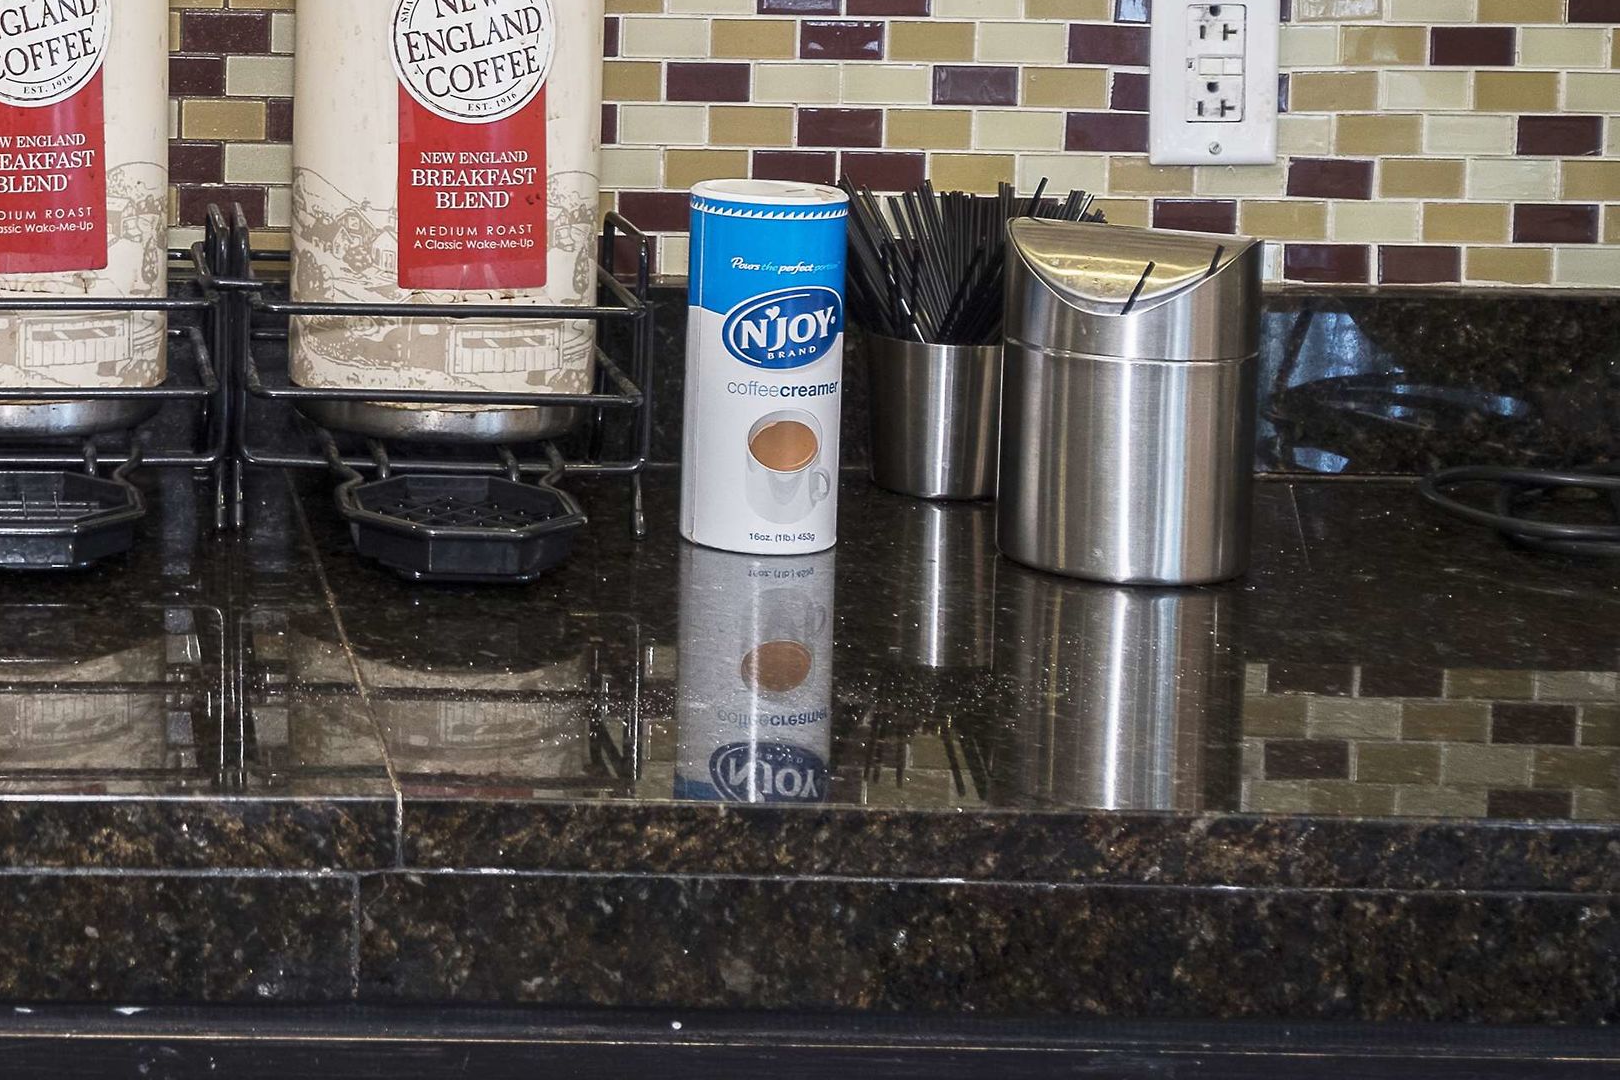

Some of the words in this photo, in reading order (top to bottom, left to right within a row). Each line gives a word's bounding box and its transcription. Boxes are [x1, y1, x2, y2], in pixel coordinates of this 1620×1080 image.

[403, 6, 542, 64] ENGLAND
[425, 46, 541, 97] COFFEE
[23, 83, 47, 94] EST.
[52, 75, 73, 90] 1916
[467, 102, 492, 111] EST.
[496, 92, 517, 107] 1916
[16, 133, 86, 148] ENGLAND
[420, 151, 455, 164] NEW
[459, 150, 528, 164] ENGLAND
[411, 167, 537, 186] BREAKFAST
[435, 191, 510, 209] BLEND
[45, 206, 93, 219] ROAST
[25, 221, 94, 233] Wake-Me-Up
[415, 226, 478, 236] MEDIUM
[486, 224, 533, 236] ROAST
[413, 240, 422, 249] A
[425, 239, 463, 250] Classic
[466, 238, 534, 249] Wake-Me-Up
[730, 256, 761, 271] Pours
[777, 261, 814, 275] perfect
[767, 345, 817, 360] BRAND
